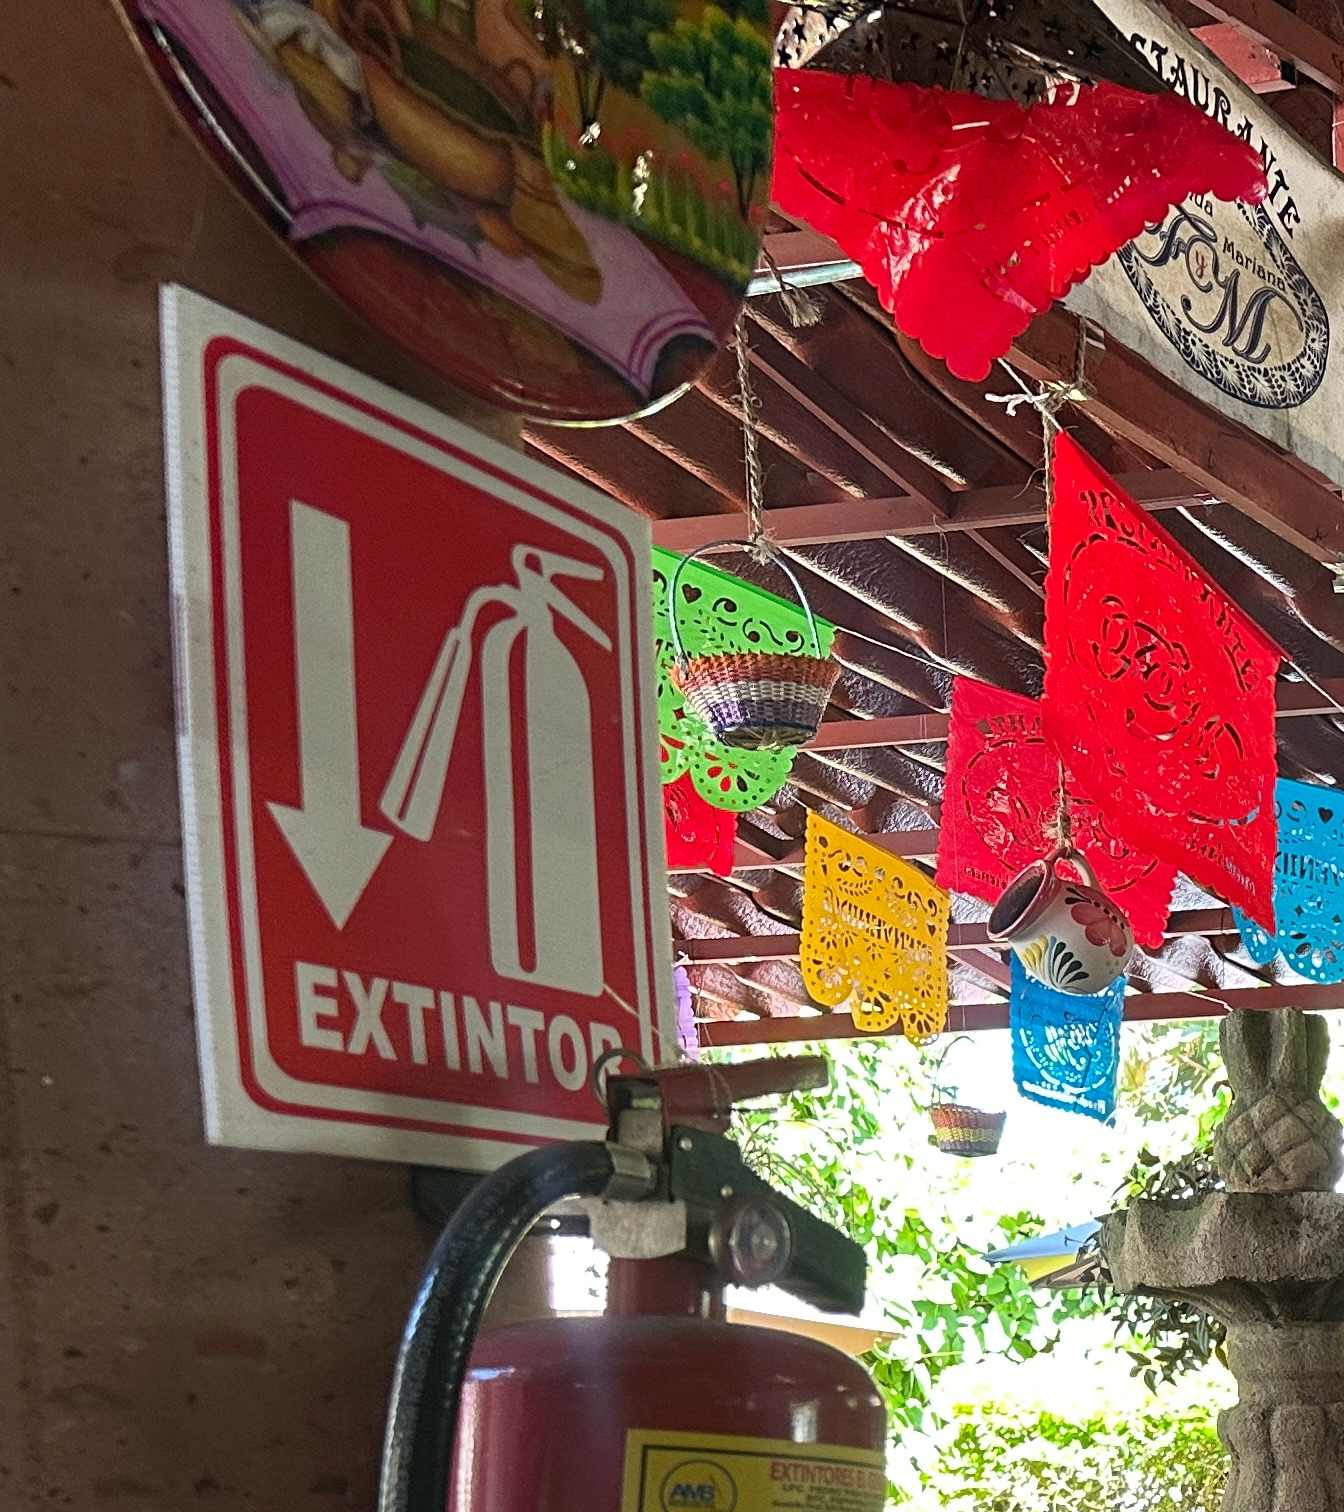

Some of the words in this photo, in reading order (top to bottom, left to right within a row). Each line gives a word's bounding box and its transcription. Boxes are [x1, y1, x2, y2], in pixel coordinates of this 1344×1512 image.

[1194, 250, 1209, 280] y
[1223, 237, 1286, 292] Mariana
[295, 961, 624, 1092] EXTINTOR
